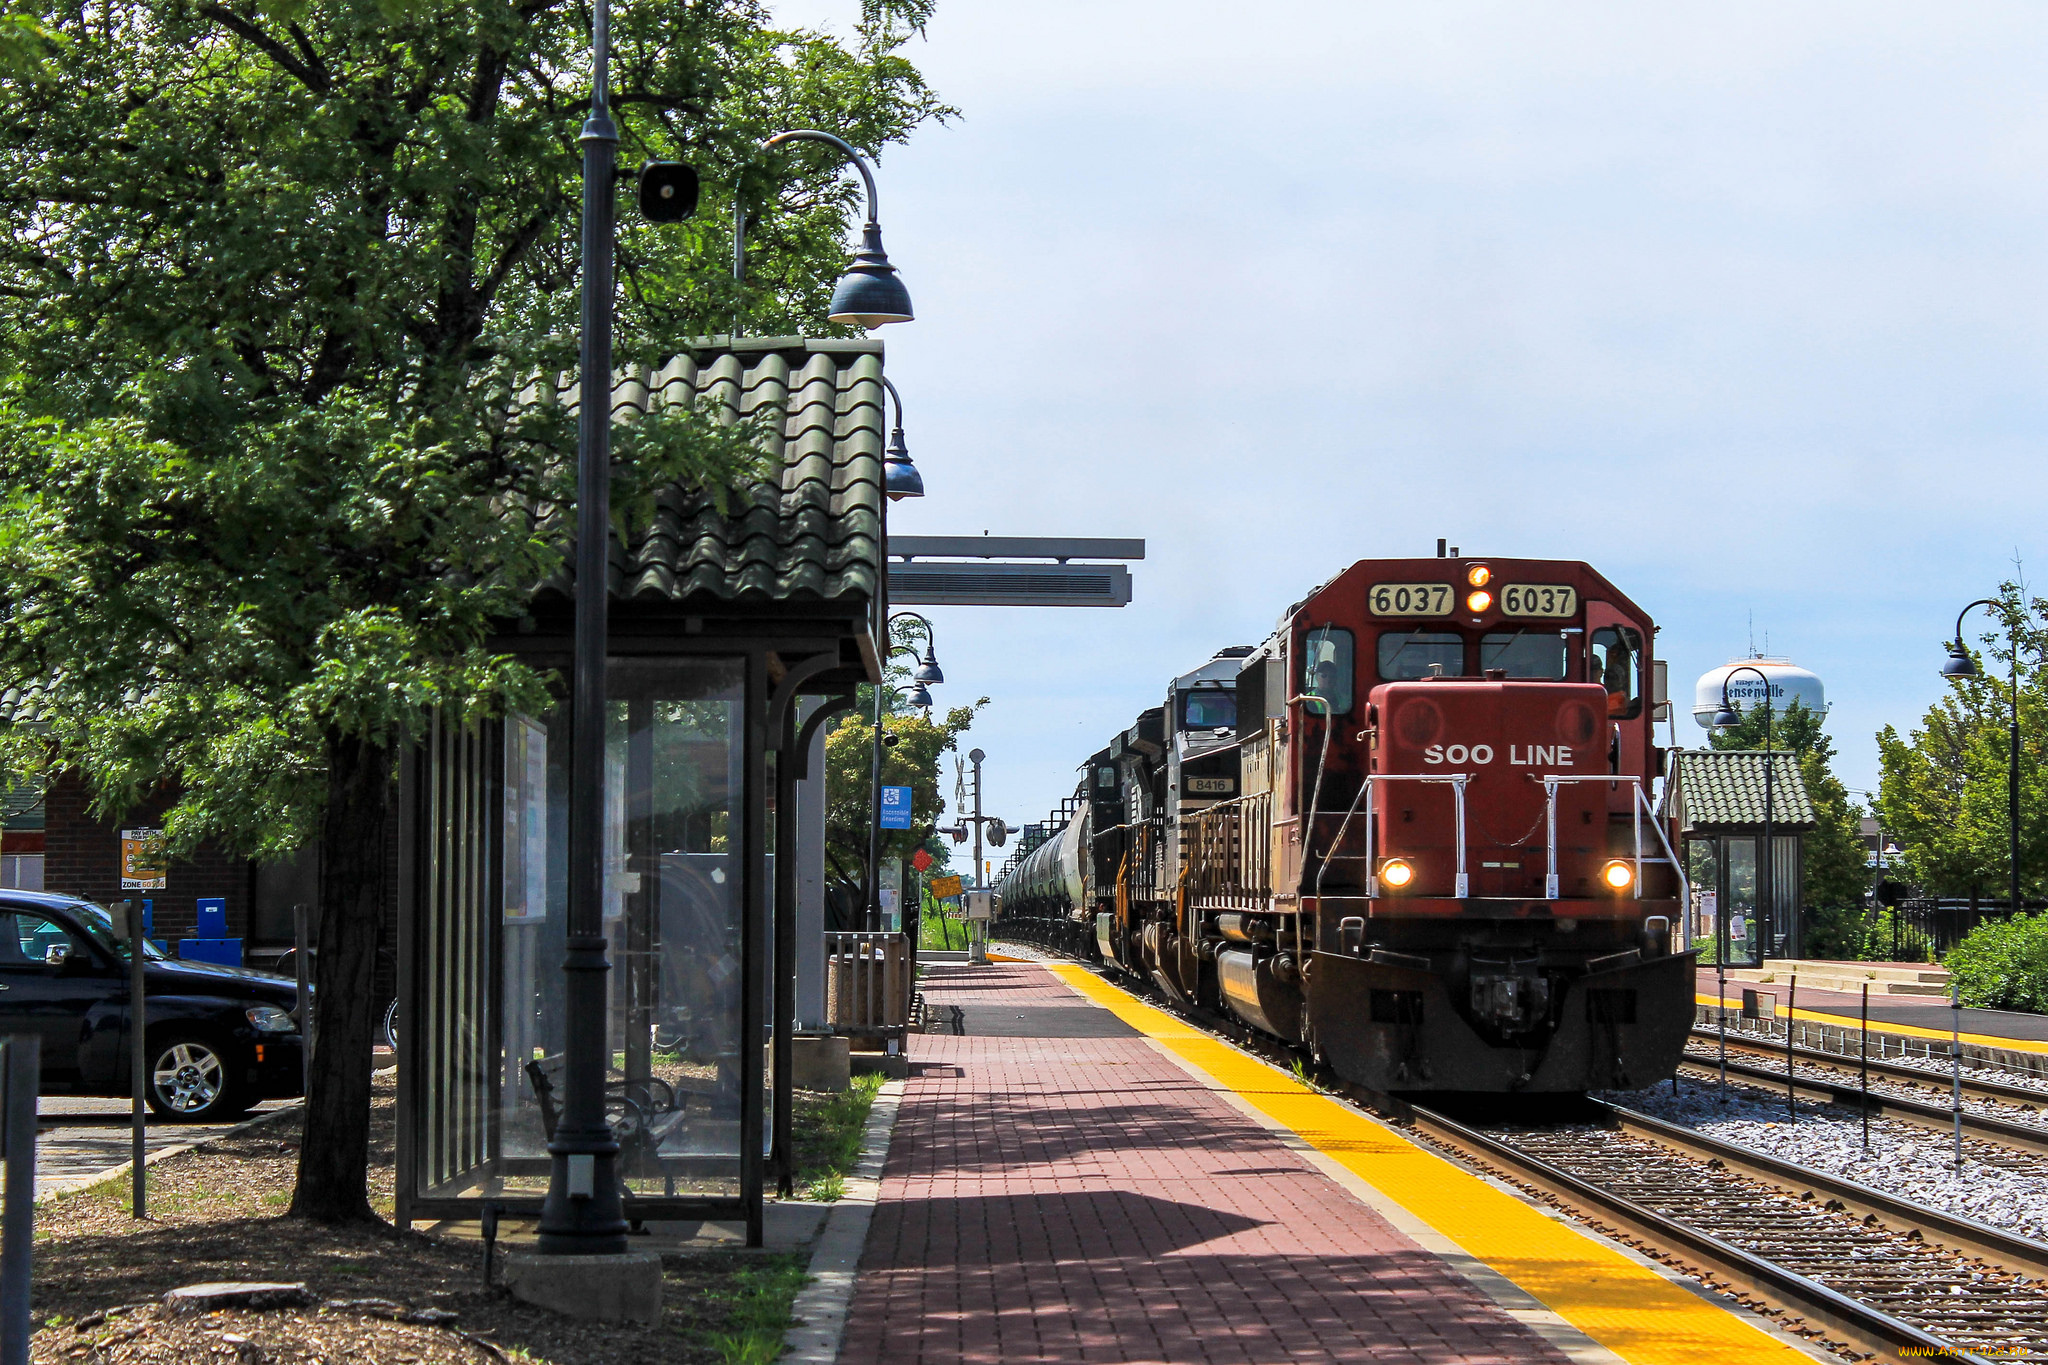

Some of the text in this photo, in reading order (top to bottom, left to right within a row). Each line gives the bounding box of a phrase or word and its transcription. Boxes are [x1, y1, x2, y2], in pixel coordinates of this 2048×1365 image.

[1375, 586, 1448, 613] 6037
[1506, 587, 1571, 614] 6037
[1728, 684, 1784, 699] ensenvlle
[1424, 744, 1574, 766] SOO LINE
[1196, 780, 1226, 791] 8416
